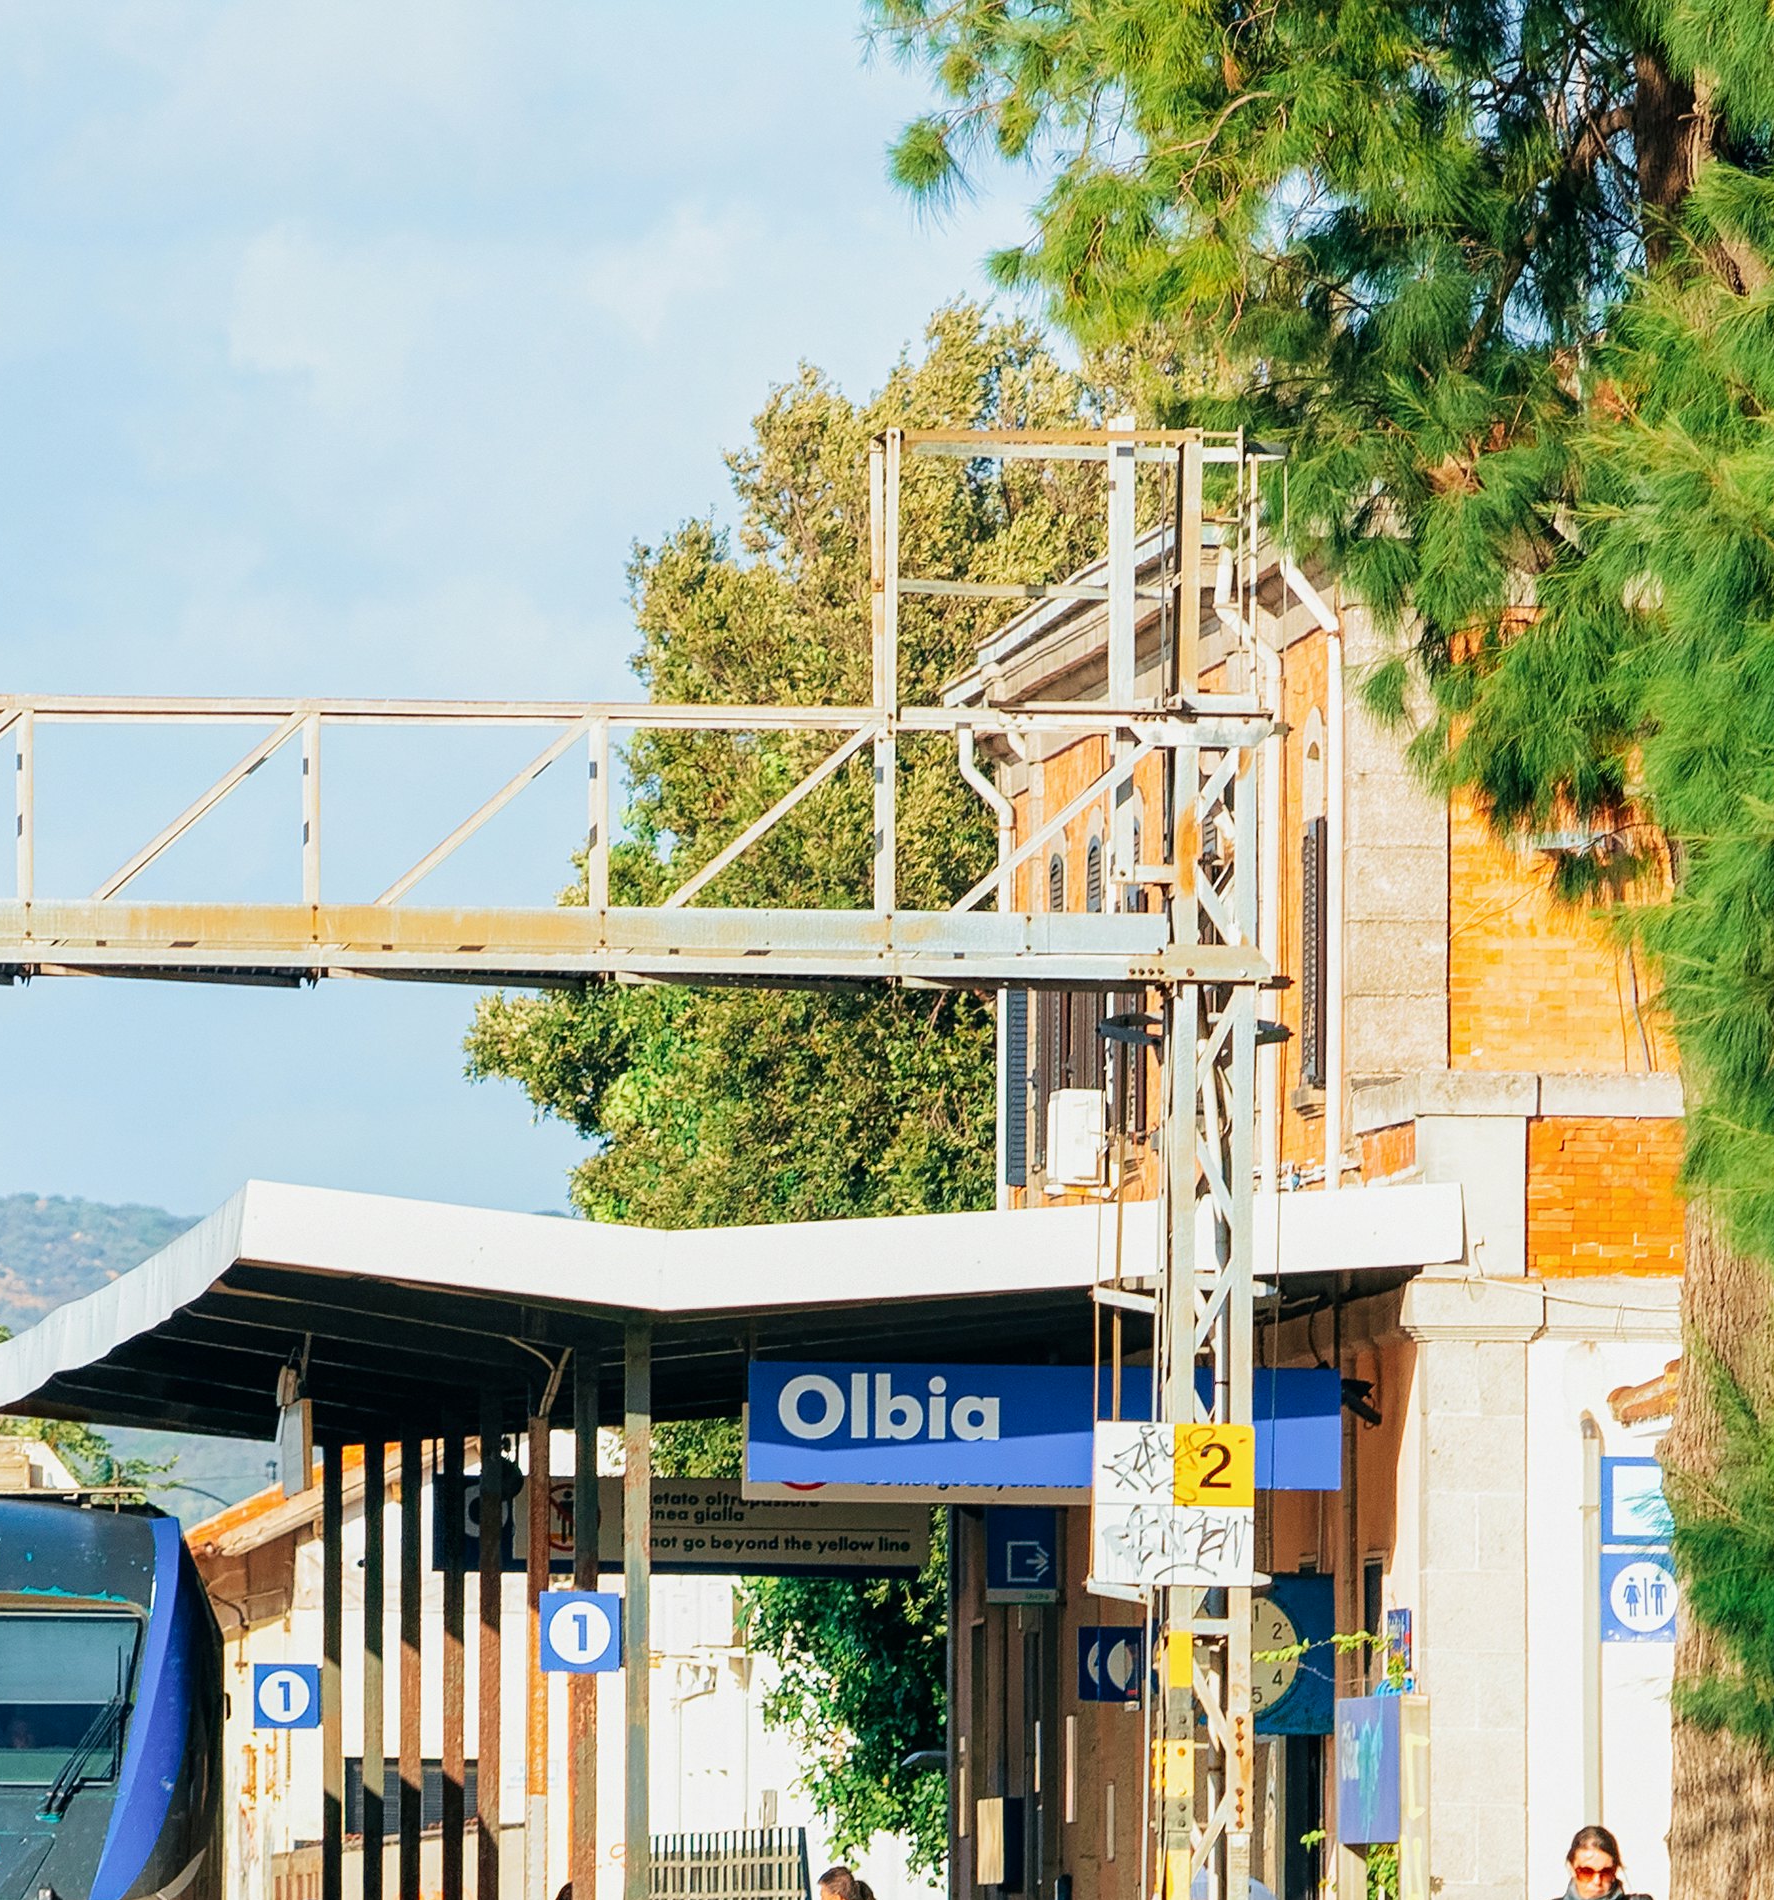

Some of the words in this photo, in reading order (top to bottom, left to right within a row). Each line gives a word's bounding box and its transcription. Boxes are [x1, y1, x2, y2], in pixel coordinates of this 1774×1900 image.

[778, 1373, 1000, 1441] Olbia
[1200, 1443, 1232, 1488] 2
[694, 1506, 745, 1524] gialla
[683, 1538, 706, 1552] go
[710, 1534, 779, 1553] beyond
[784, 1535, 812, 1550] the
[817, 1536, 874, 1554] yellow
[878, 1536, 911, 1551] line
[572, 1614, 587, 1652] 1
[1271, 1622, 1282, 1640] 2
[1272, 1669, 1283, 1687] 4
[278, 1681, 290, 1711] 1
